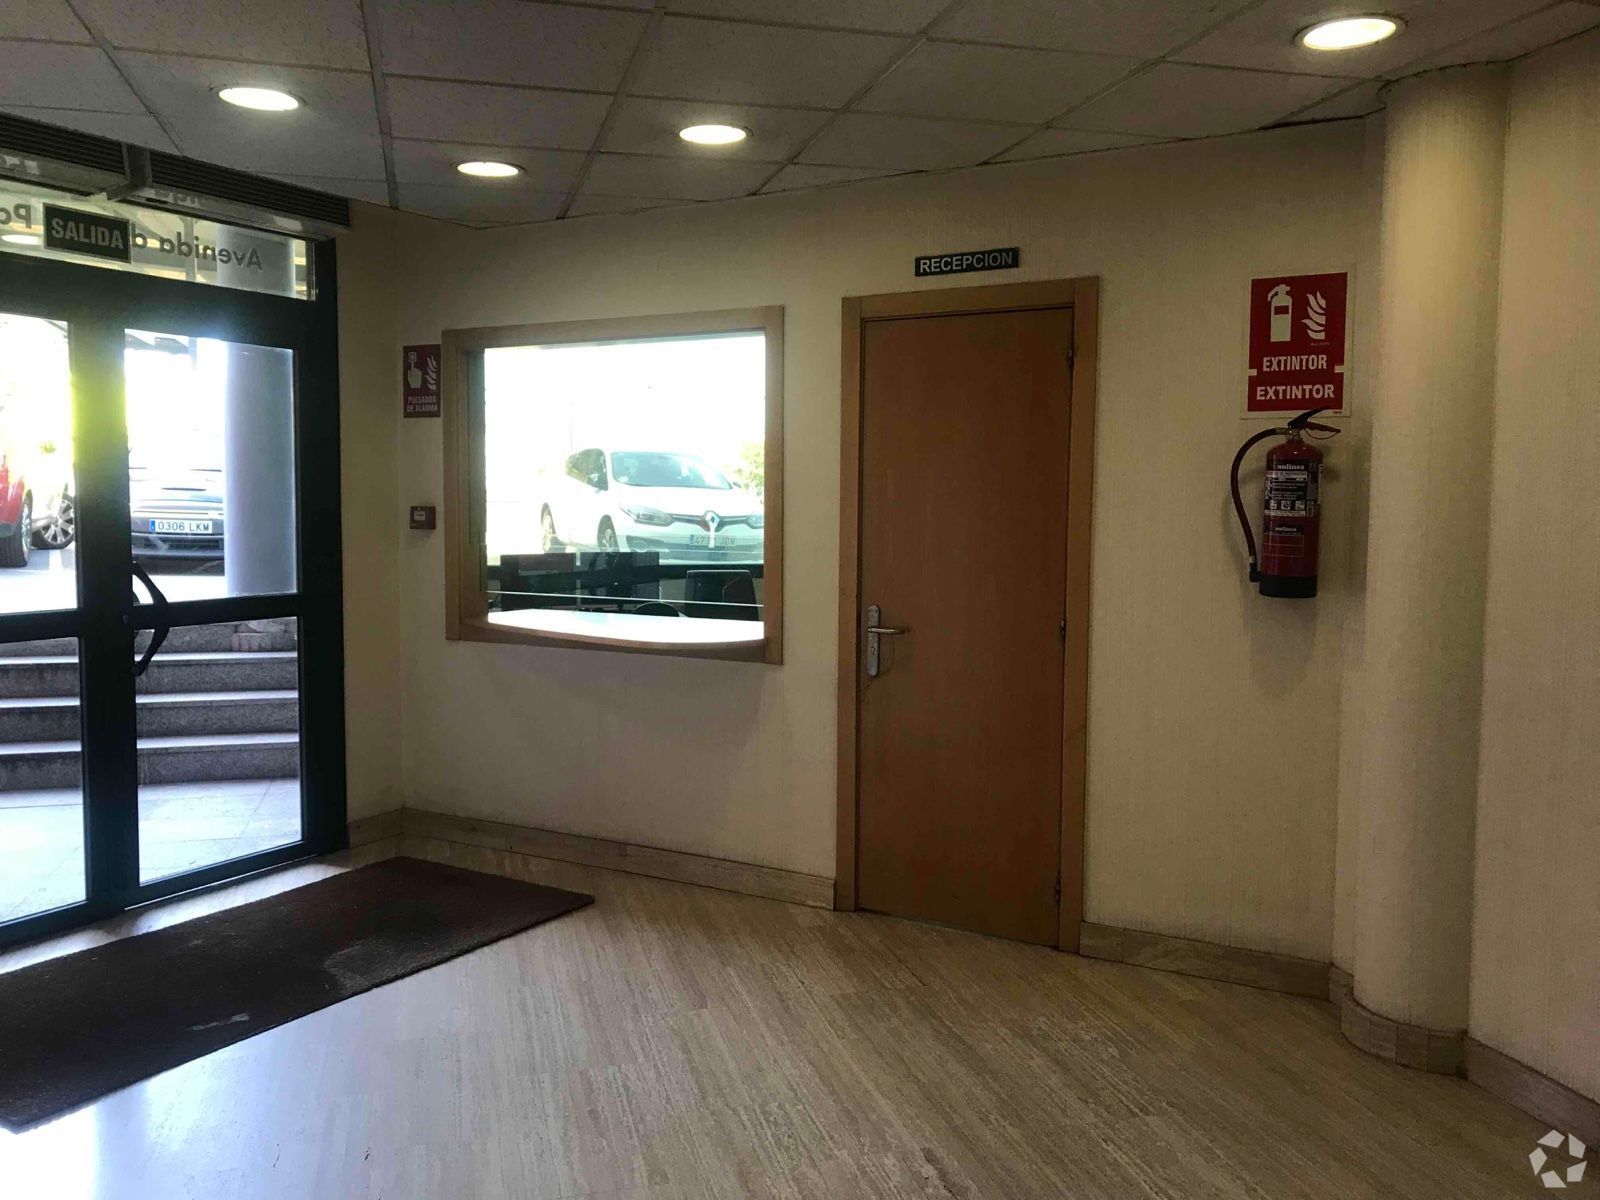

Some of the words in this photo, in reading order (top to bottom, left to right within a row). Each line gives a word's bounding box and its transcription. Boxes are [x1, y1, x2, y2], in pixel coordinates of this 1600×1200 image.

[51, 217, 124, 250] SALIDA
[920, 251, 1013, 273] RECEPCION
[1262, 354, 1328, 372] EXTINTOR
[1256, 383, 1335, 400] EXTINTOR
[158, 521, 185, 531] 0306
[189, 522, 210, 532] LKM
